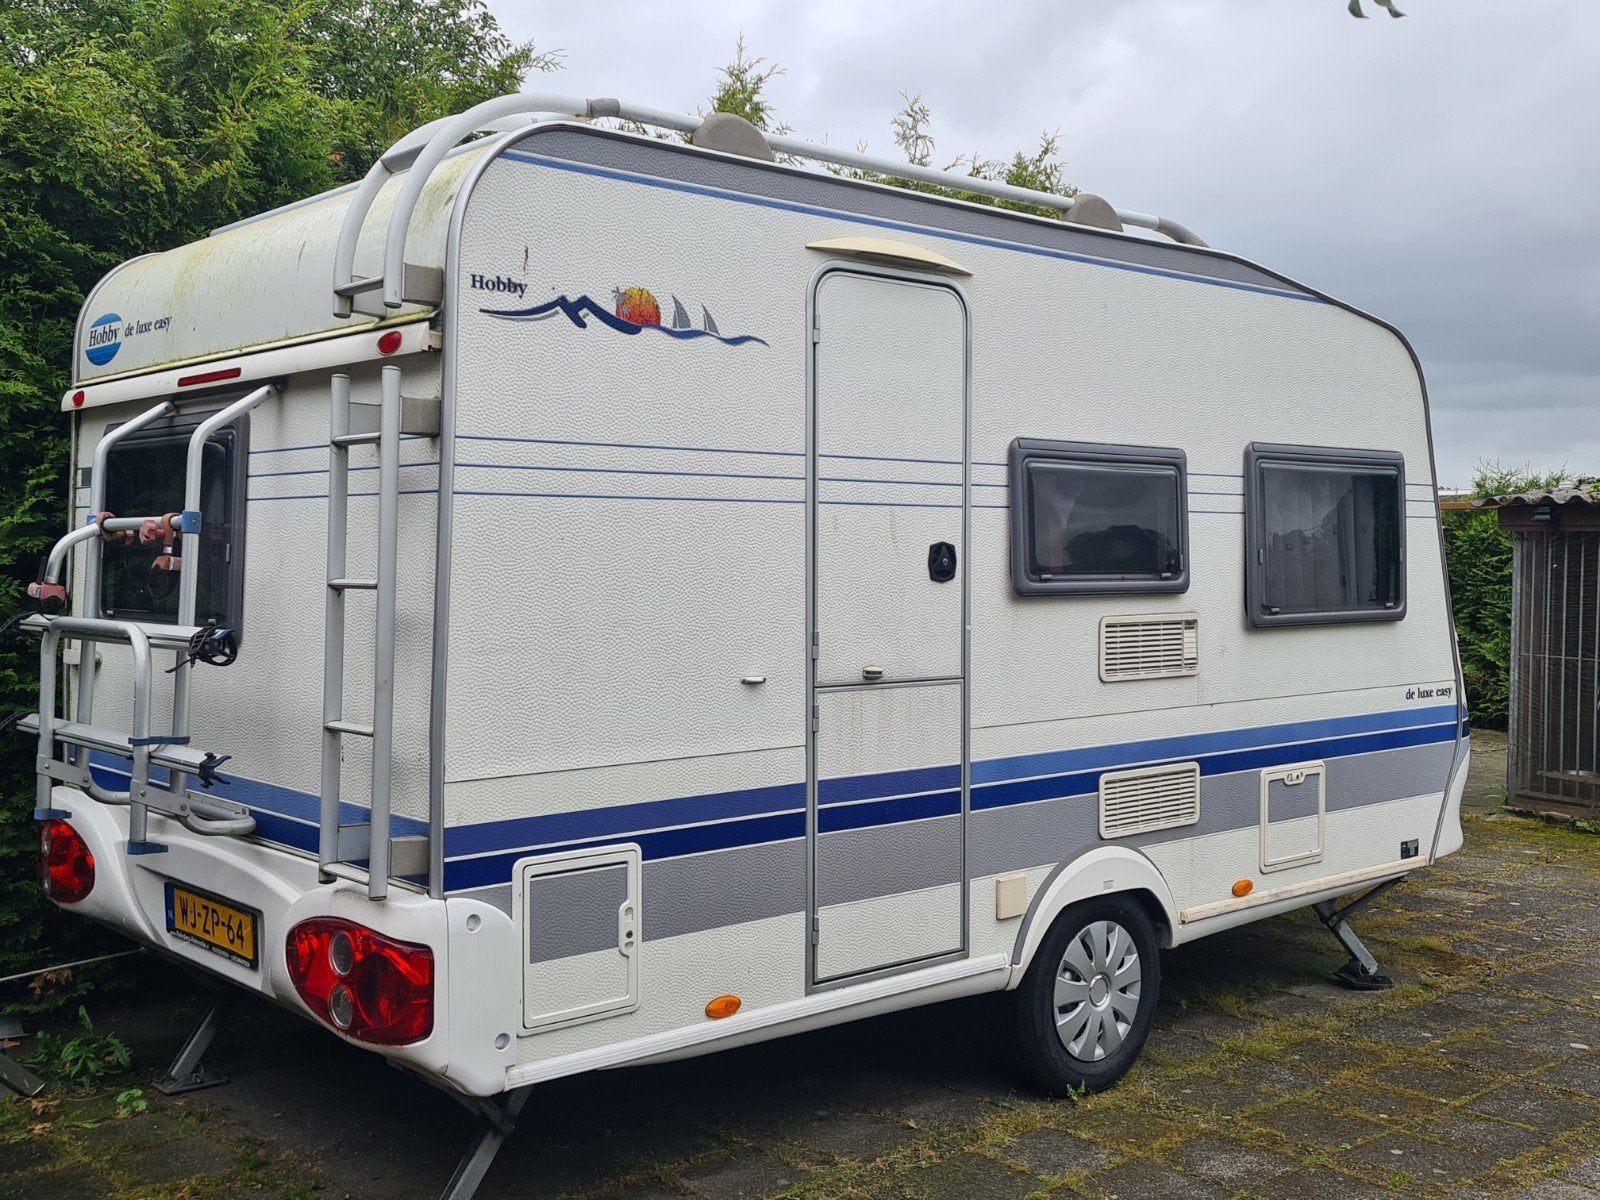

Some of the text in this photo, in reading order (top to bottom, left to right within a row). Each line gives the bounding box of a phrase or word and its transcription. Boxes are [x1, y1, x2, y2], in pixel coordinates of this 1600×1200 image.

[470, 274, 528, 299] Hobby
[89, 325, 120, 347] Hobby
[124, 317, 172, 337] de luxe easy
[1405, 687, 1452, 700] de luxe easy
[179, 895, 245, 950] WJ-ZP-64
